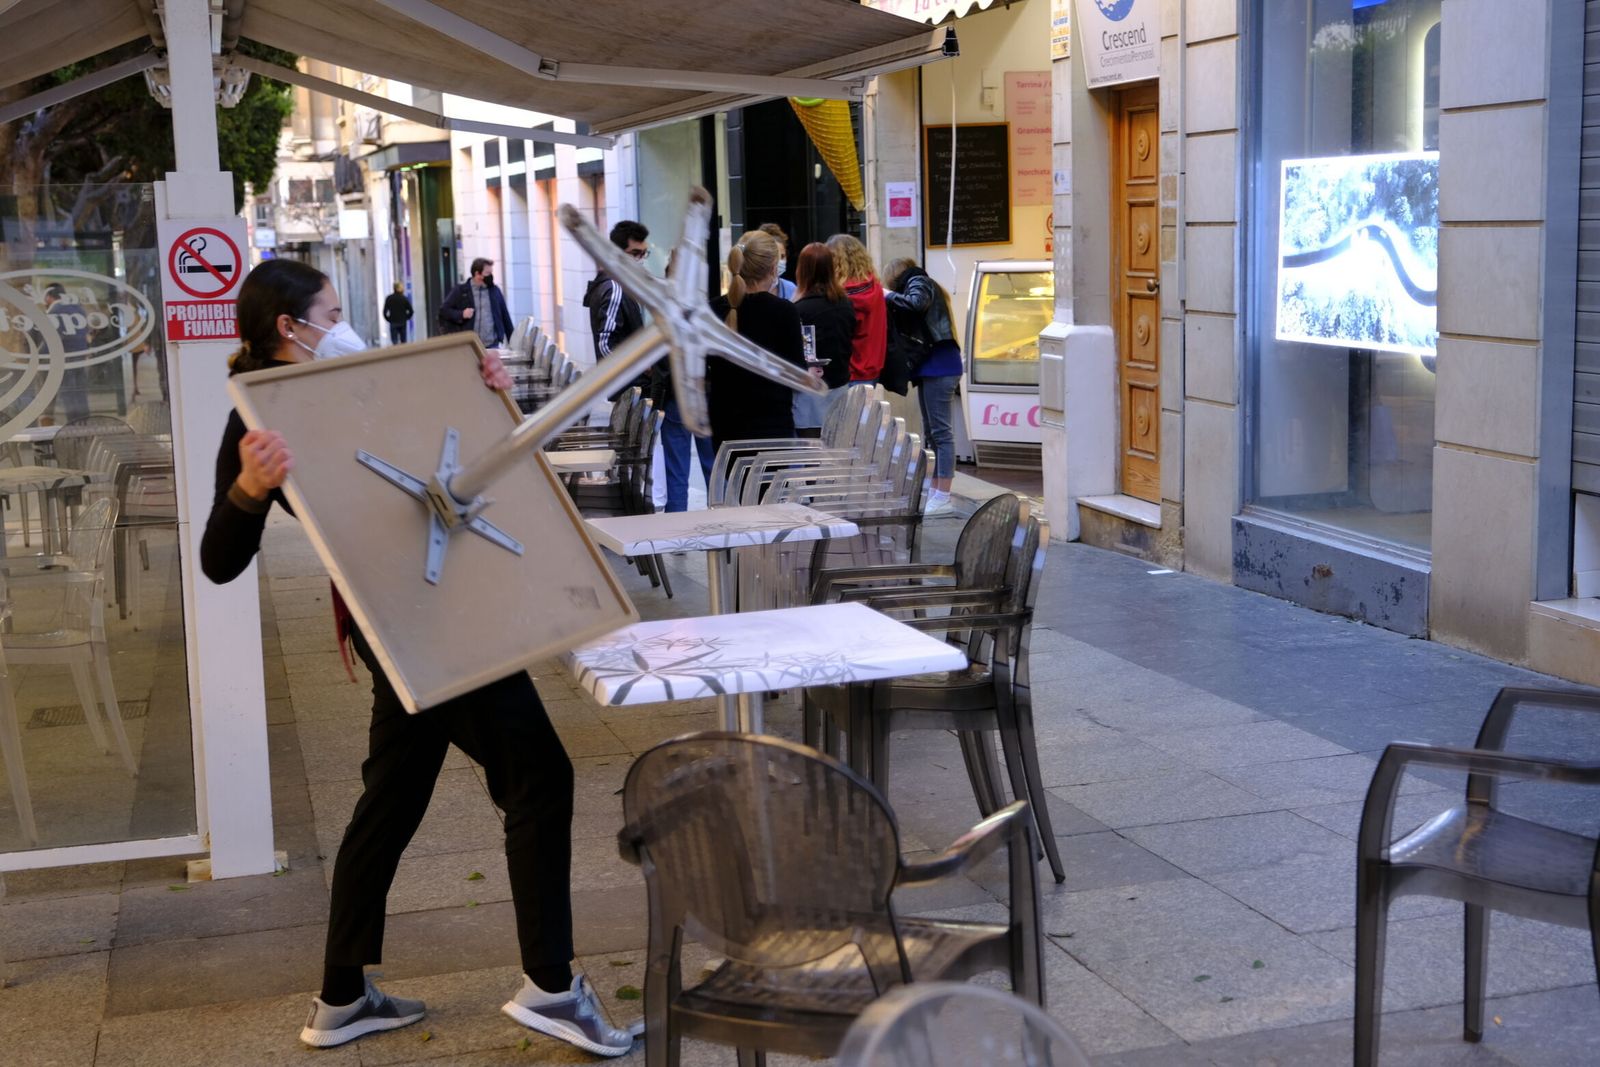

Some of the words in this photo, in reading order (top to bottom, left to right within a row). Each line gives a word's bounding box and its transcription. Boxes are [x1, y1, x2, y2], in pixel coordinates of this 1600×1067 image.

[1102, 22, 1147, 51] Crescend
[184, 319, 236, 337] FUMAR
[982, 404, 1019, 426] La
